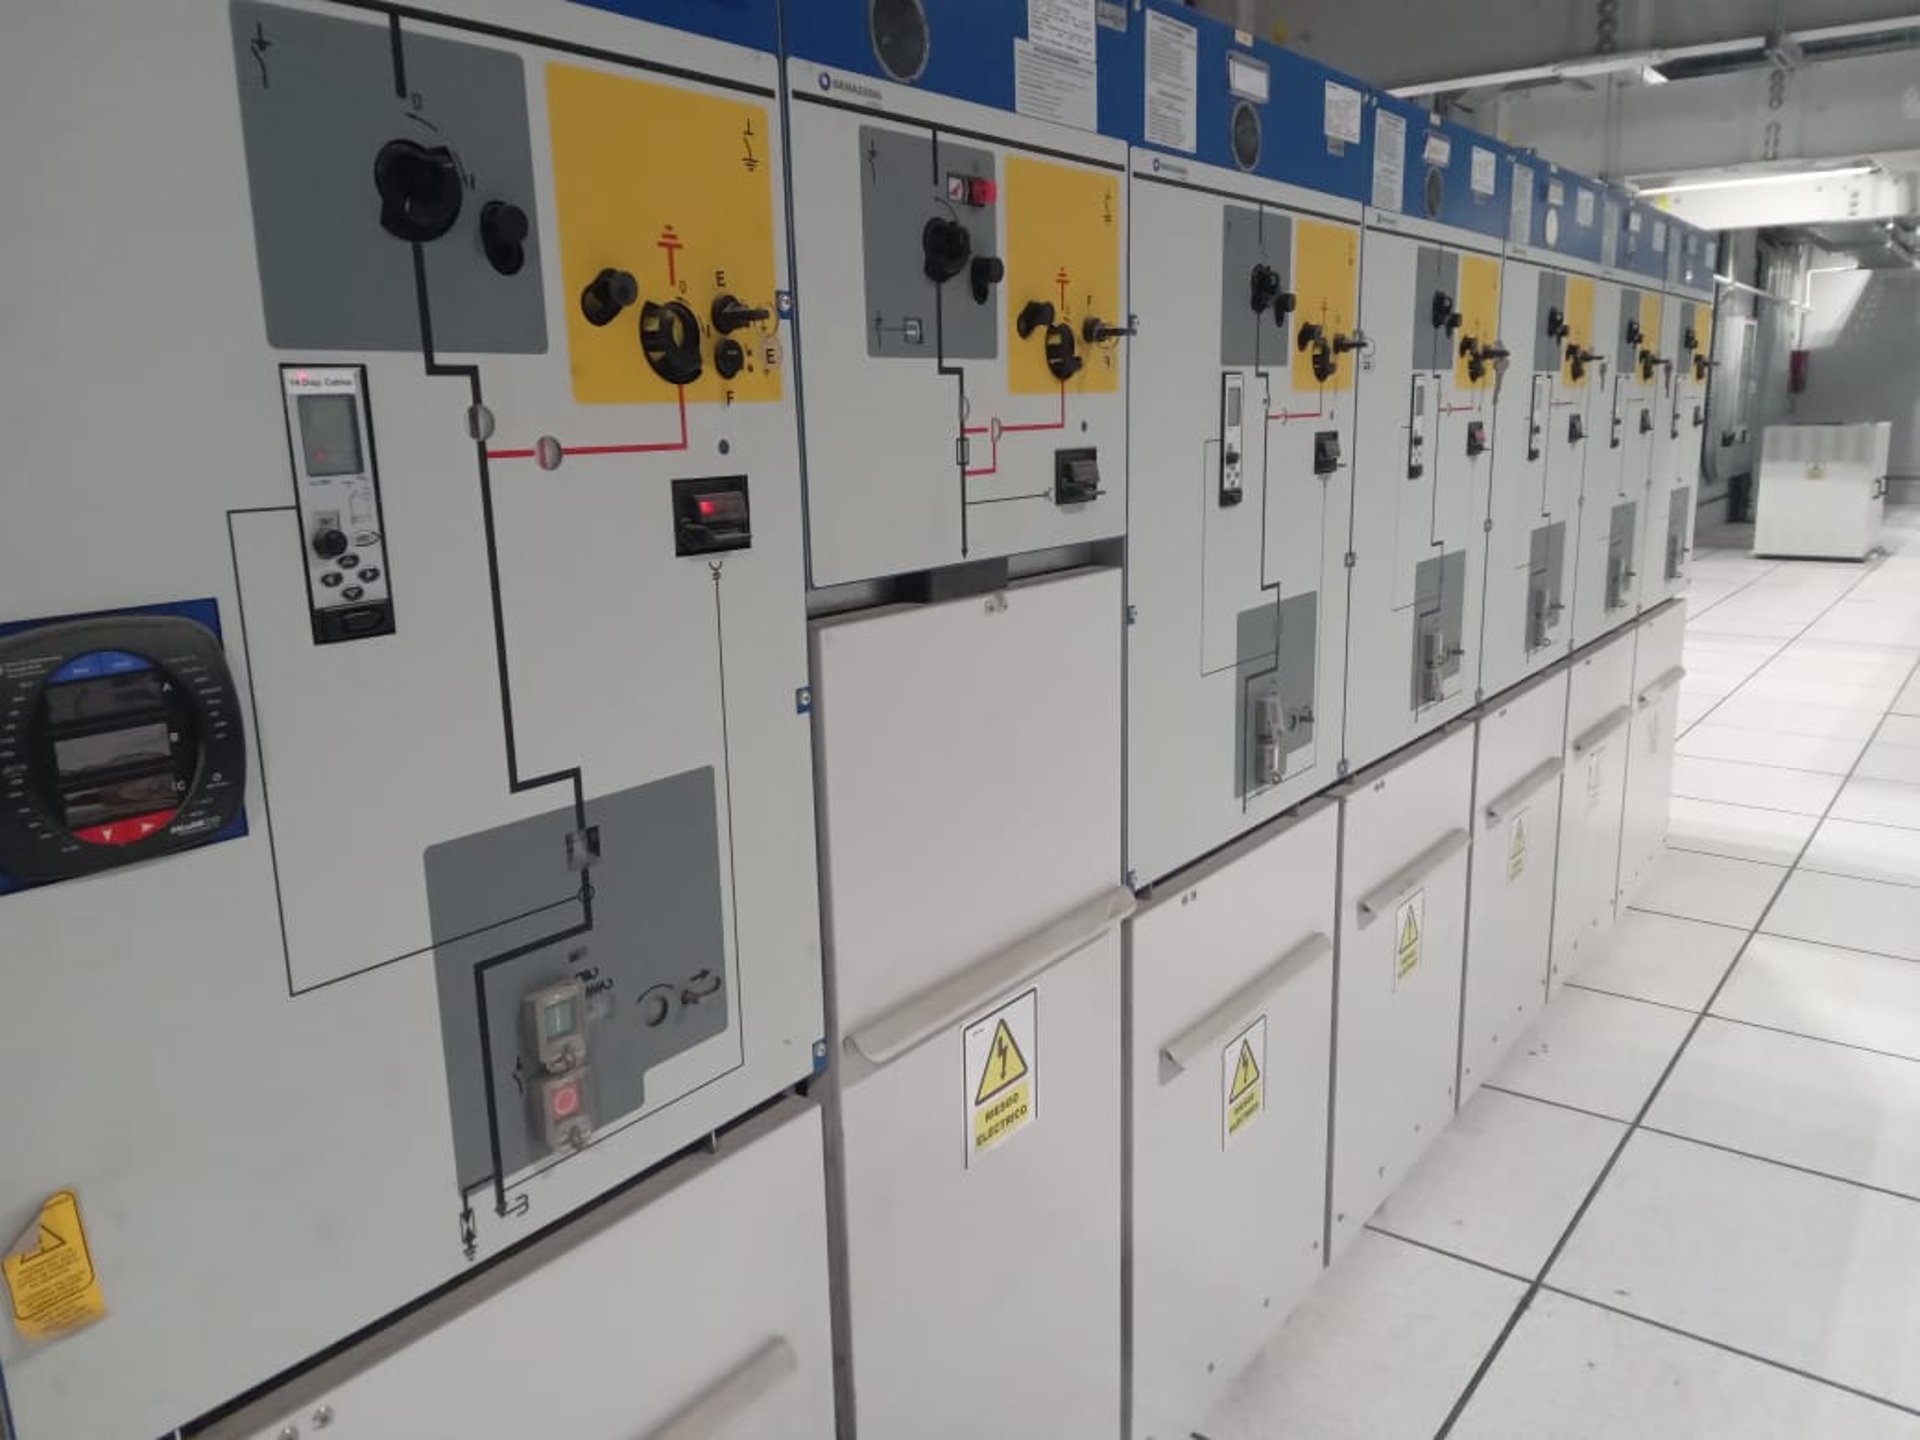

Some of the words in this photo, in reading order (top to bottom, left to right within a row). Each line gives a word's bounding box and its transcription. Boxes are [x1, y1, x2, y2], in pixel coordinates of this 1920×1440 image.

[716, 270, 726, 287] E
[766, 348, 776, 365] E
[726, 390, 735, 406] F
[985, 1092, 1019, 1123] RIESGO
